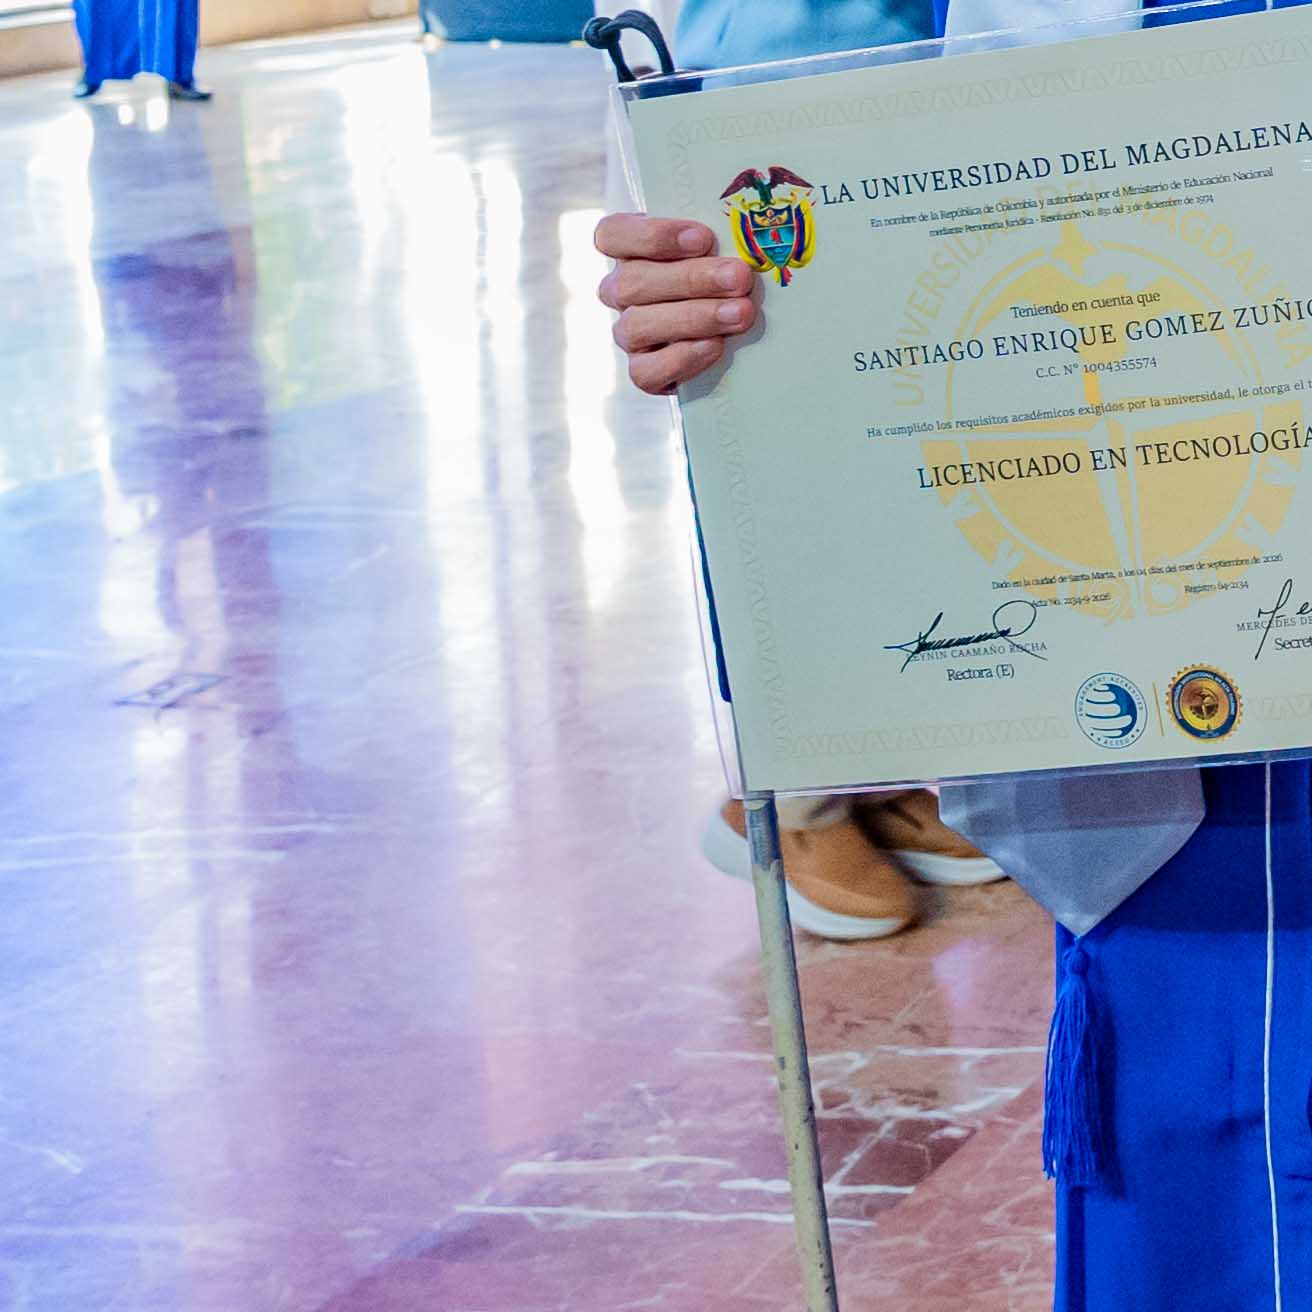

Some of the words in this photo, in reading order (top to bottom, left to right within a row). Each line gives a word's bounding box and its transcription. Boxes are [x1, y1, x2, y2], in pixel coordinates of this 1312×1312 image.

[820, 183, 855, 205] LA
[860, 157, 1051, 199] UNIVERSIDAD
[1060, 148, 1116, 174] DEL
[1009, 300, 1069, 318] Teniendo
[1071, 301, 1088, 311] en
[1090, 295, 1134, 309] cuenta
[1136, 292, 1160, 307] que
[854, 339, 984, 371] SANTIAGO
[992, 324, 1116, 356] ENRIQUE
[1125, 311, 1224, 341] GOMEZ
[1035, 366, 1060, 378] C.C.
[1083, 356, 1157, 373] 1004355574
[867, 427, 882, 438] Ha
[884, 422, 934, 437] cumplido
[935, 420, 953, 430] los
[955, 415, 1008, 430] requisitos
[1011, 407, 1075, 422] académicos
[1077, 402, 1124, 416] exigidos
[1127, 400, 1146, 413] por
[1149, 397, 1160, 407] la
[1164, 388, 1235, 406] universidad,
[1237, 387, 1249, 398] le
[1252, 383, 1291, 396] otorga
[1293, 379, 1304, 391] el
[916, 452, 1081, 488] LICENCIADO
[1089, 447, 1126, 471] EN
[946, 668, 993, 681] Rectora
[995, 663, 1015, 679] (E)
